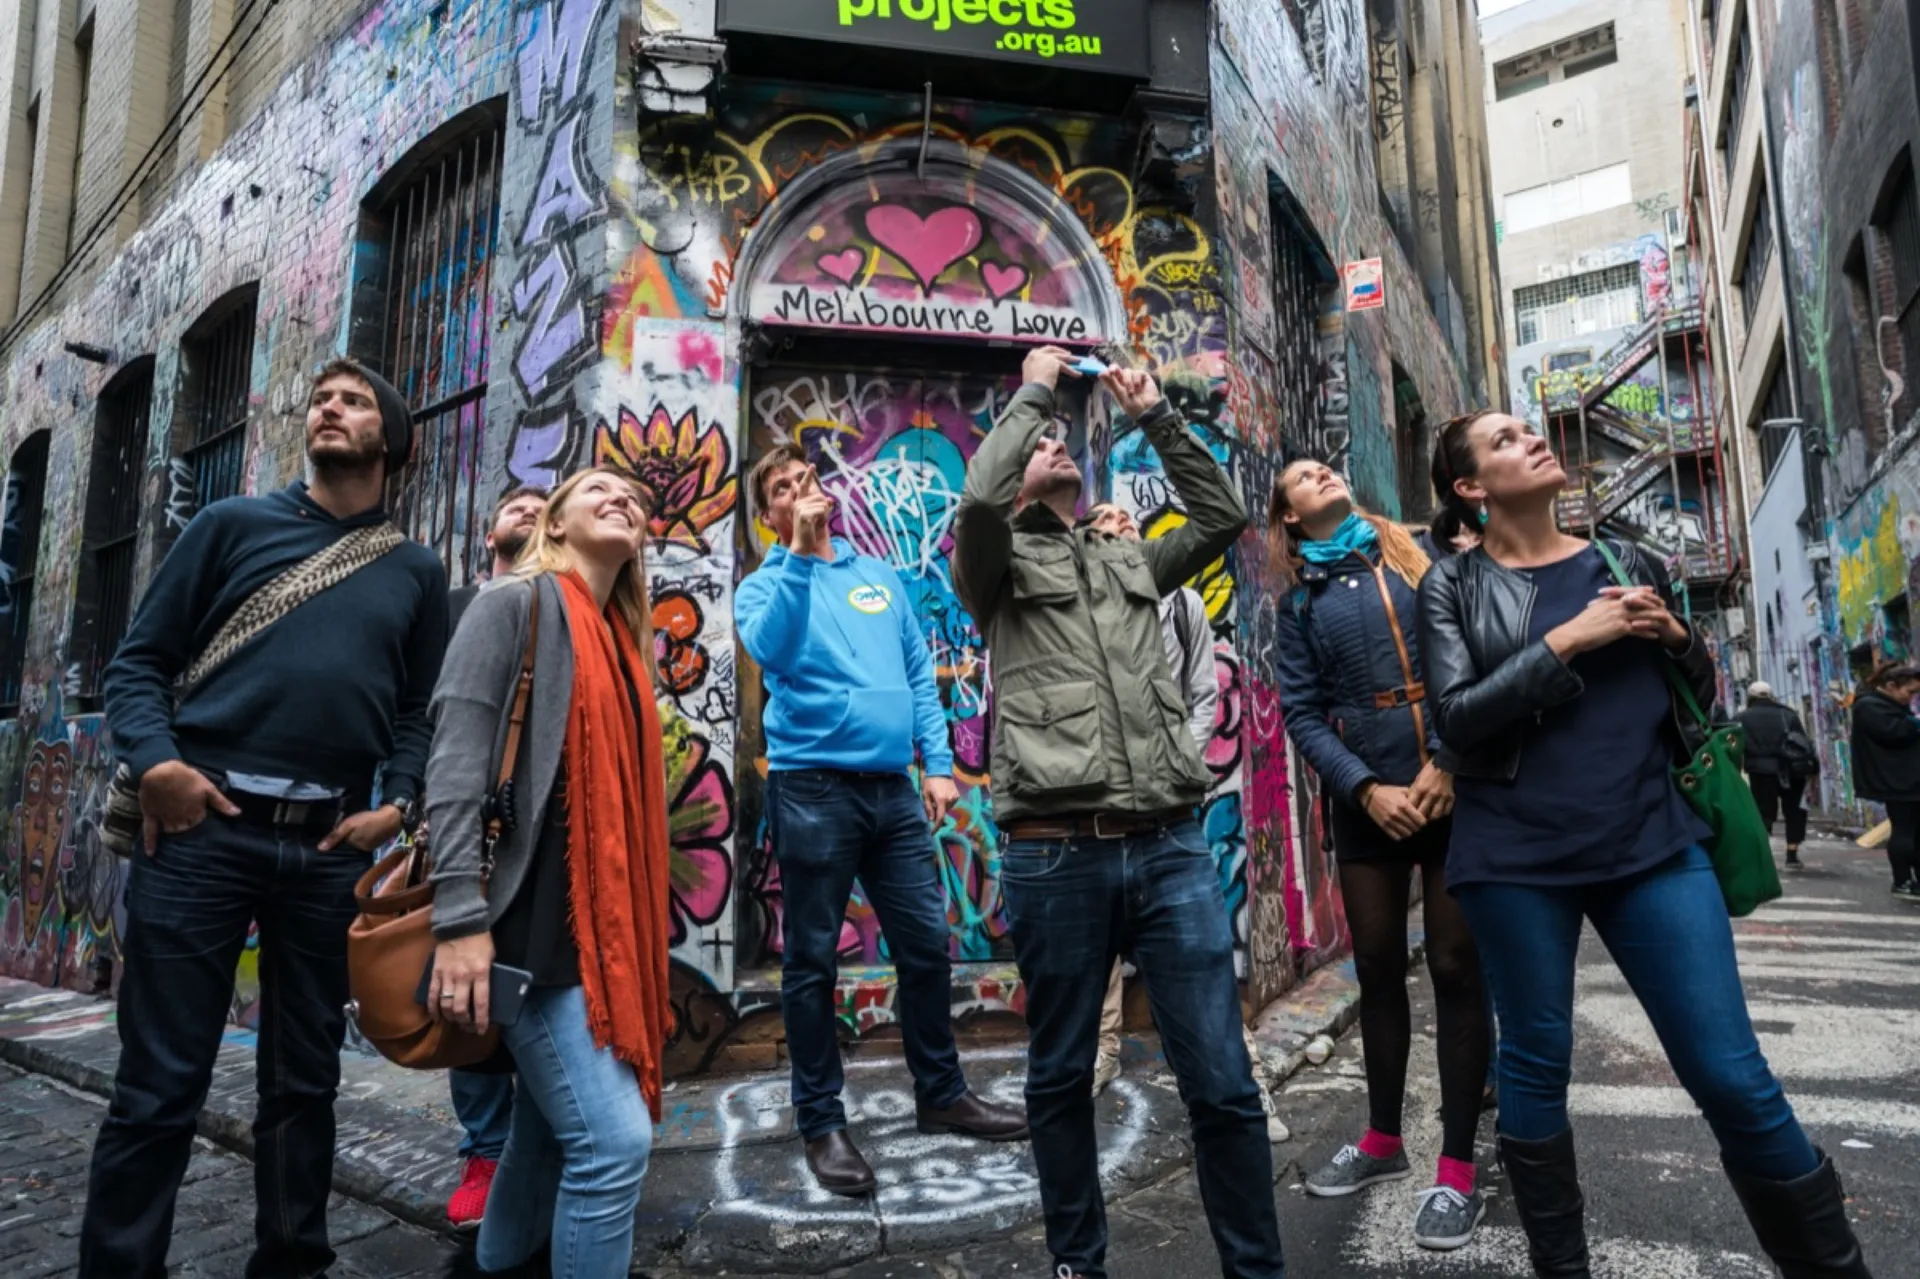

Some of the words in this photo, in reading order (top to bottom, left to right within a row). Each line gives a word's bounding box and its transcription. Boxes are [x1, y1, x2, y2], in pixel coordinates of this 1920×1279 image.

[838, 0, 1076, 30] projects
[996, 31, 1101, 57] .org.au
[1011, 304, 1086, 340] Love
